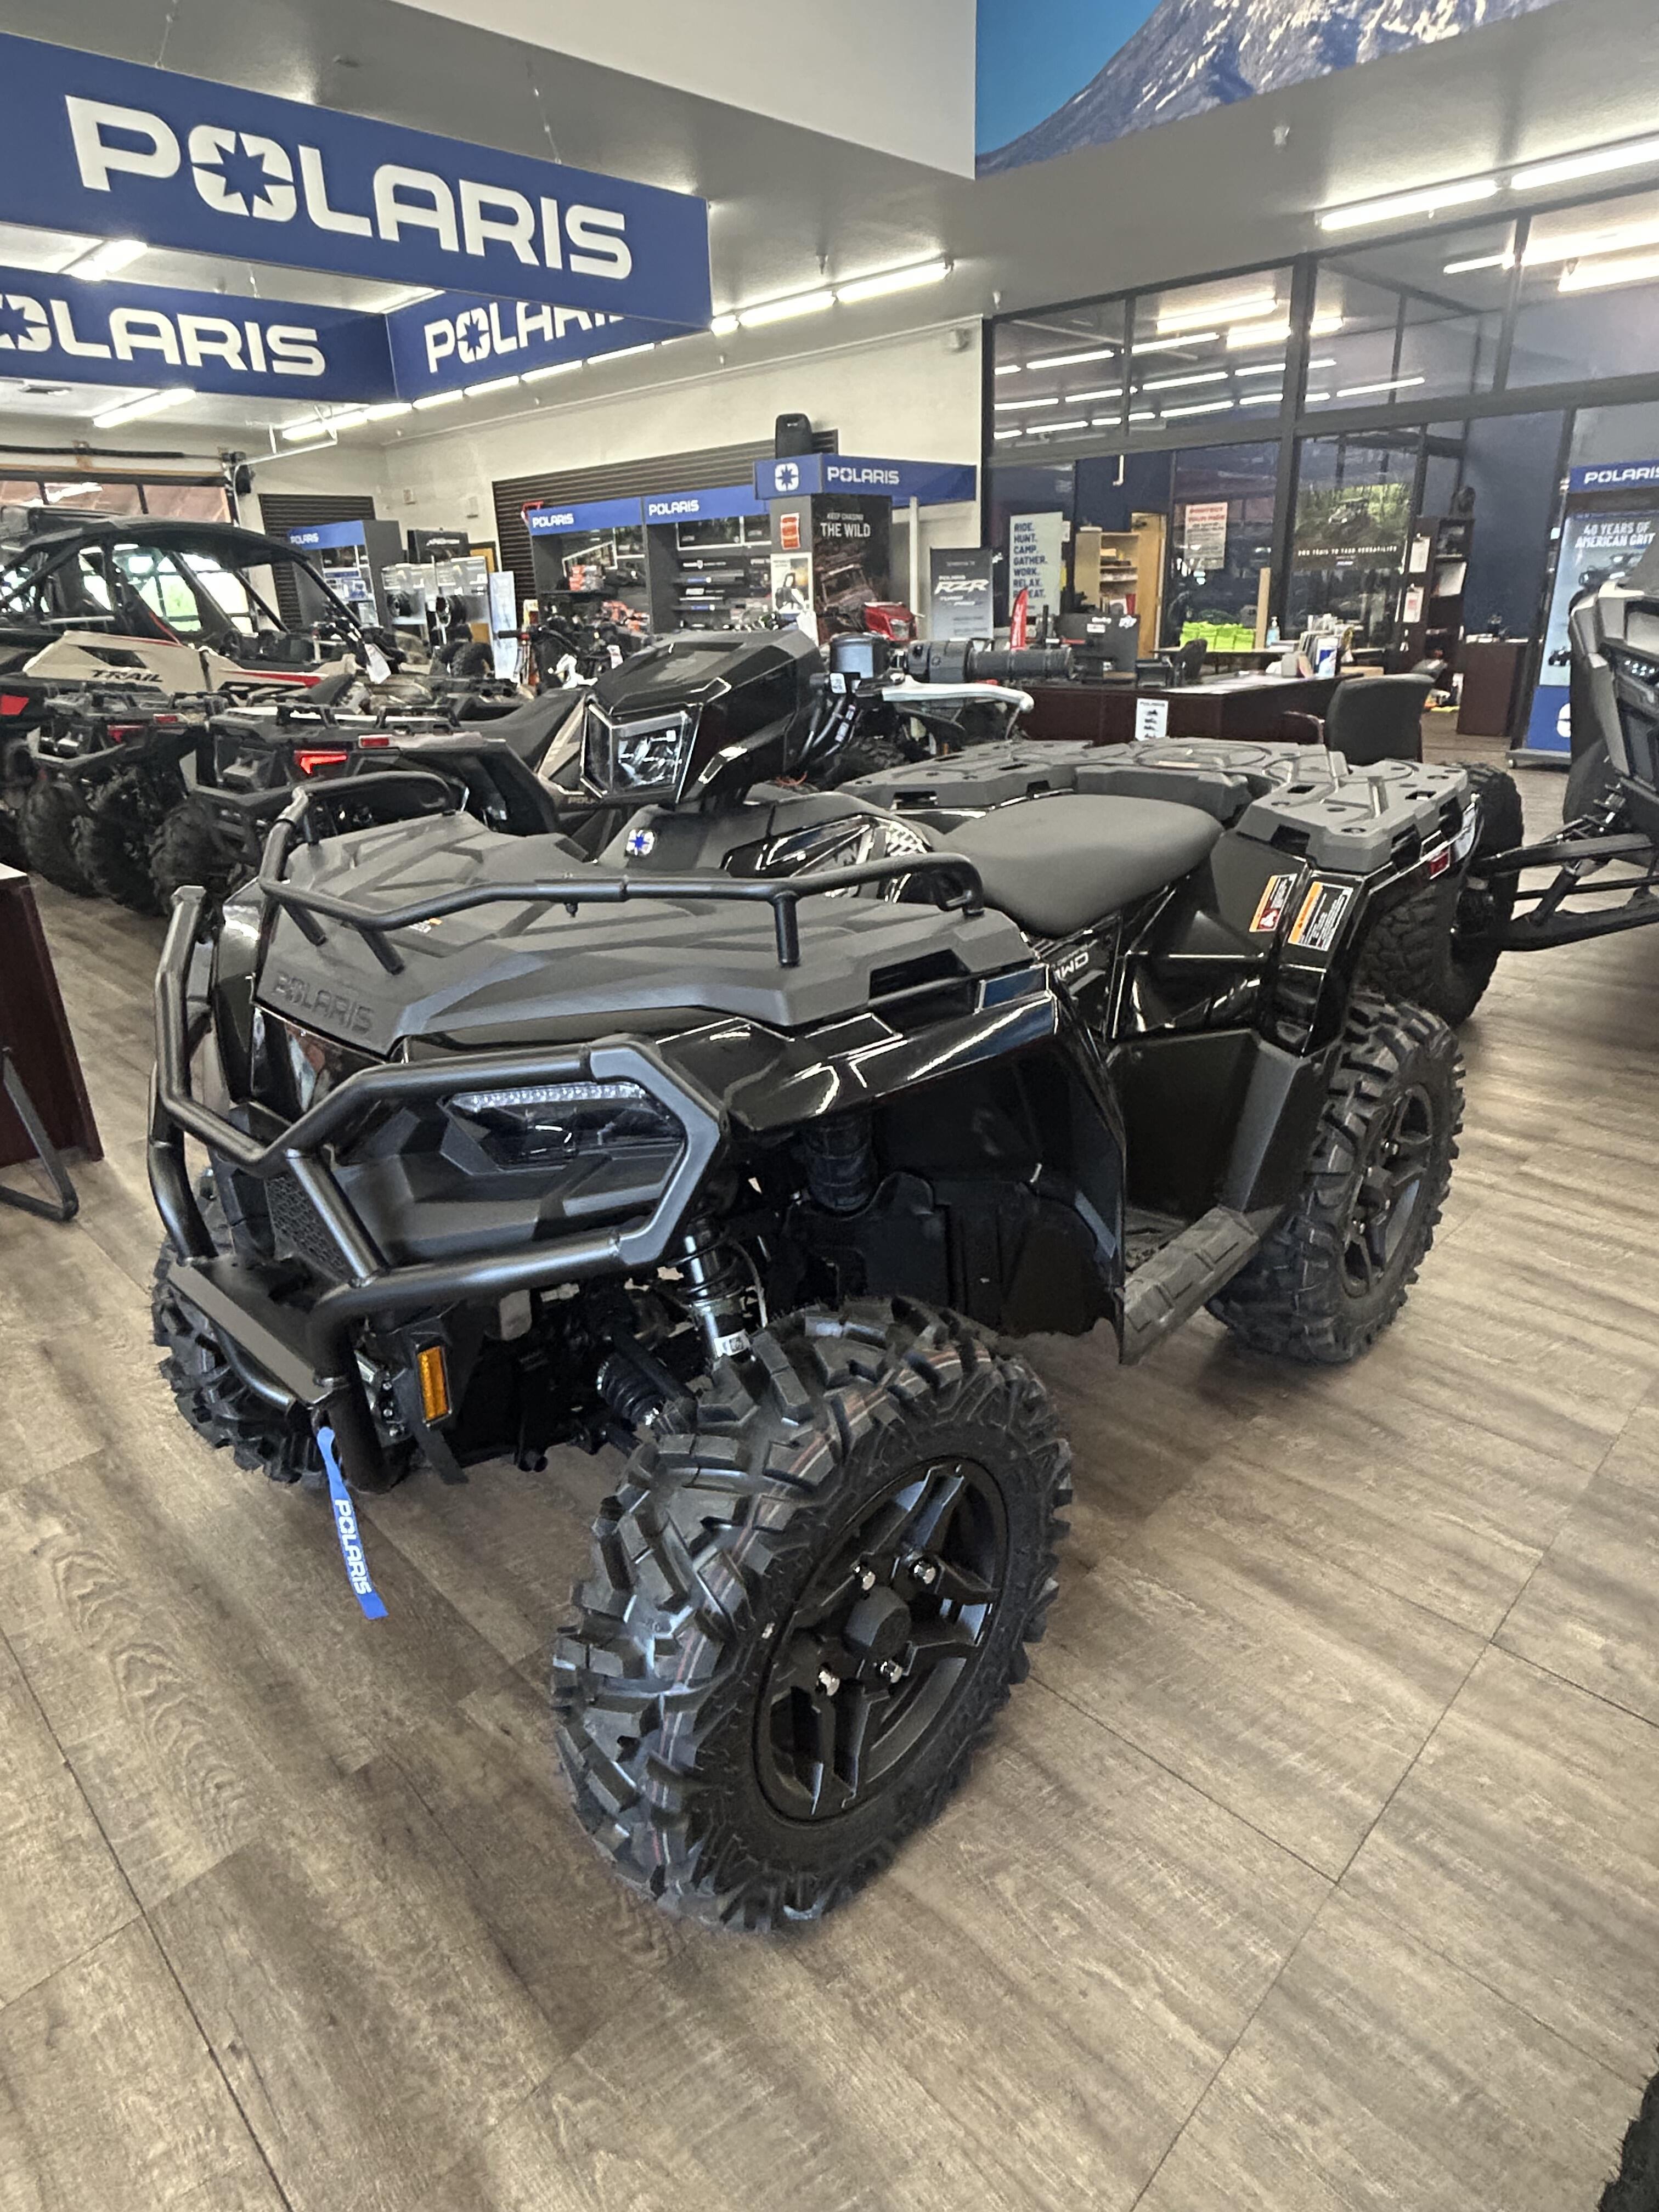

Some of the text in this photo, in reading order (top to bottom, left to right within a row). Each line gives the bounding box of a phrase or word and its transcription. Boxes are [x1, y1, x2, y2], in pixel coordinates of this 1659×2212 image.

[65, 95, 632, 280] POLARIS
[0, 294, 325, 376] OLARIS
[424, 301, 625, 373] POLAR
[827, 466, 900, 485] POLARIS
[648, 500, 699, 516] POLARIS
[532, 513, 574, 528] POLARIS
[1584, 521, 1651, 535] 40 YEARS OF
[820, 523, 871, 538] THE WILD
[1014, 533, 1037, 543] HUNT.
[290, 532, 319, 545] POLARIS
[1575, 532, 1656, 548] AMERICAN GRIT
[1014, 545, 1039, 554] CAMP.
[1013, 555, 1048, 566] GATHER.
[1013, 567, 1039, 576] WORK.
[934, 579, 989, 595] RZR
[1013, 578, 1042, 588] RELAX.
[92, 669, 163, 682] TRAIL
[275, 971, 374, 1035] POLARIS
[335, 1499, 372, 1595] POLARIS
